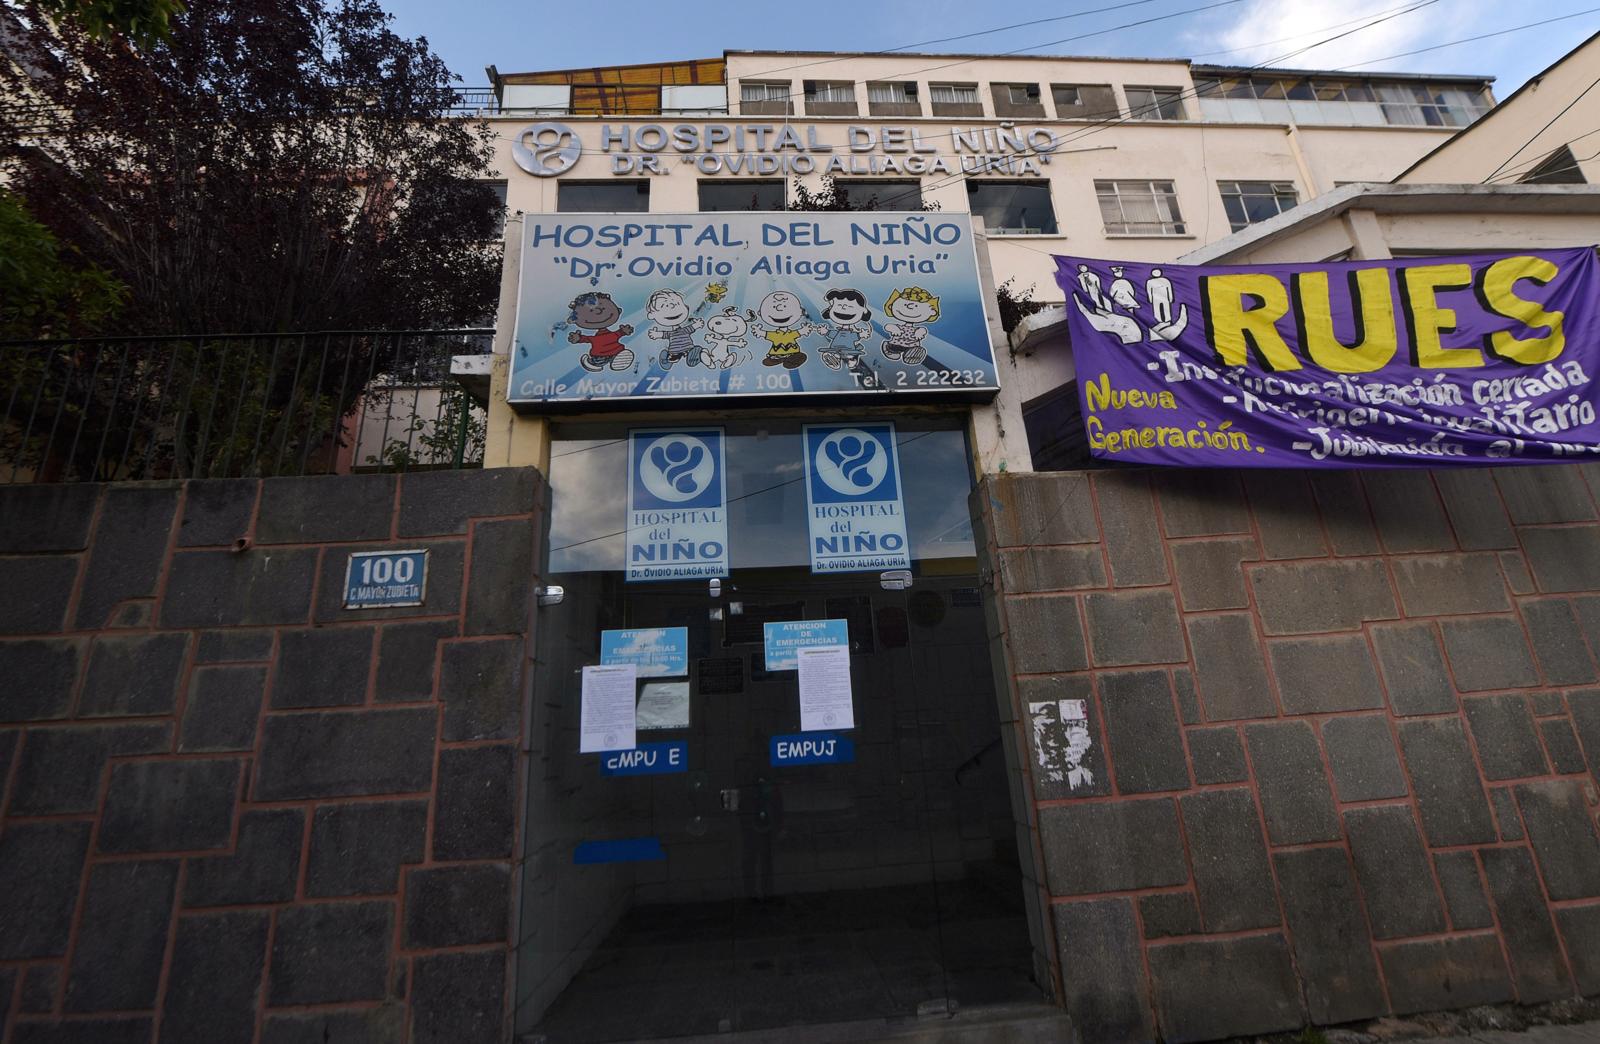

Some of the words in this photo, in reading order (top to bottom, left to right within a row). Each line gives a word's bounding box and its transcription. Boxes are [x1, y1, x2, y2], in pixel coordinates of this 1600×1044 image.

[602, 124, 833, 153] HOSPITAL
[848, 126, 937, 153] DEL
[951, 121, 1058, 153] NIÑO
[611, 153, 671, 175] DR.
[681, 153, 816, 175] "OVIDIO
[825, 153, 951, 175] ALIAGA
[960, 153, 1051, 177] URIA"
[532, 223, 744, 248] HOSPITAL
[761, 222, 834, 247] DEL
[850, 216, 961, 246] NIÑO
[553, 256, 623, 279] "Dr.
[627, 254, 733, 278] Ovidio
[750, 254, 851, 281] Aliaga
[866, 253, 949, 274] Uria"
[1200, 255, 1565, 373] RUES
[520, 379, 567, 396] Calle
[575, 377, 640, 396] Mayor
[645, 375, 721, 394] Zubieta
[728, 374, 746, 390] #
[755, 373, 792, 390] 100
[849, 371, 879, 388] Tel
[896, 370, 908, 386] 2
[916, 369, 986, 386] 222232
[1471, 360, 1591, 406] cerrada
[1085, 372, 1178, 413] Nueva
[1086, 415, 1266, 453] Generación.
[634, 512, 722, 525] HOSPITAL
[815, 503, 900, 519] HOSPITAL
[649, 528, 671, 540] del
[830, 520, 852, 533] del
[632, 538, 724, 562] NIÑO
[815, 530, 904, 554] NIÑO
[361, 557, 414, 585] 100
[631, 569, 642, 578] Dr.
[644, 567, 672, 577] OVIDIO
[674, 566, 702, 576] ALIAGA
[816, 561, 827, 570] Dr.
[828, 559, 856, 569] OVIDIO
[857, 558, 886, 568] ALIAGA
[620, 629, 667, 639] ATEN
[783, 622, 826, 631] ATENCION
[612, 645, 677, 655] EMECIAS
[776, 637, 838, 647] EMERGENCIAS
